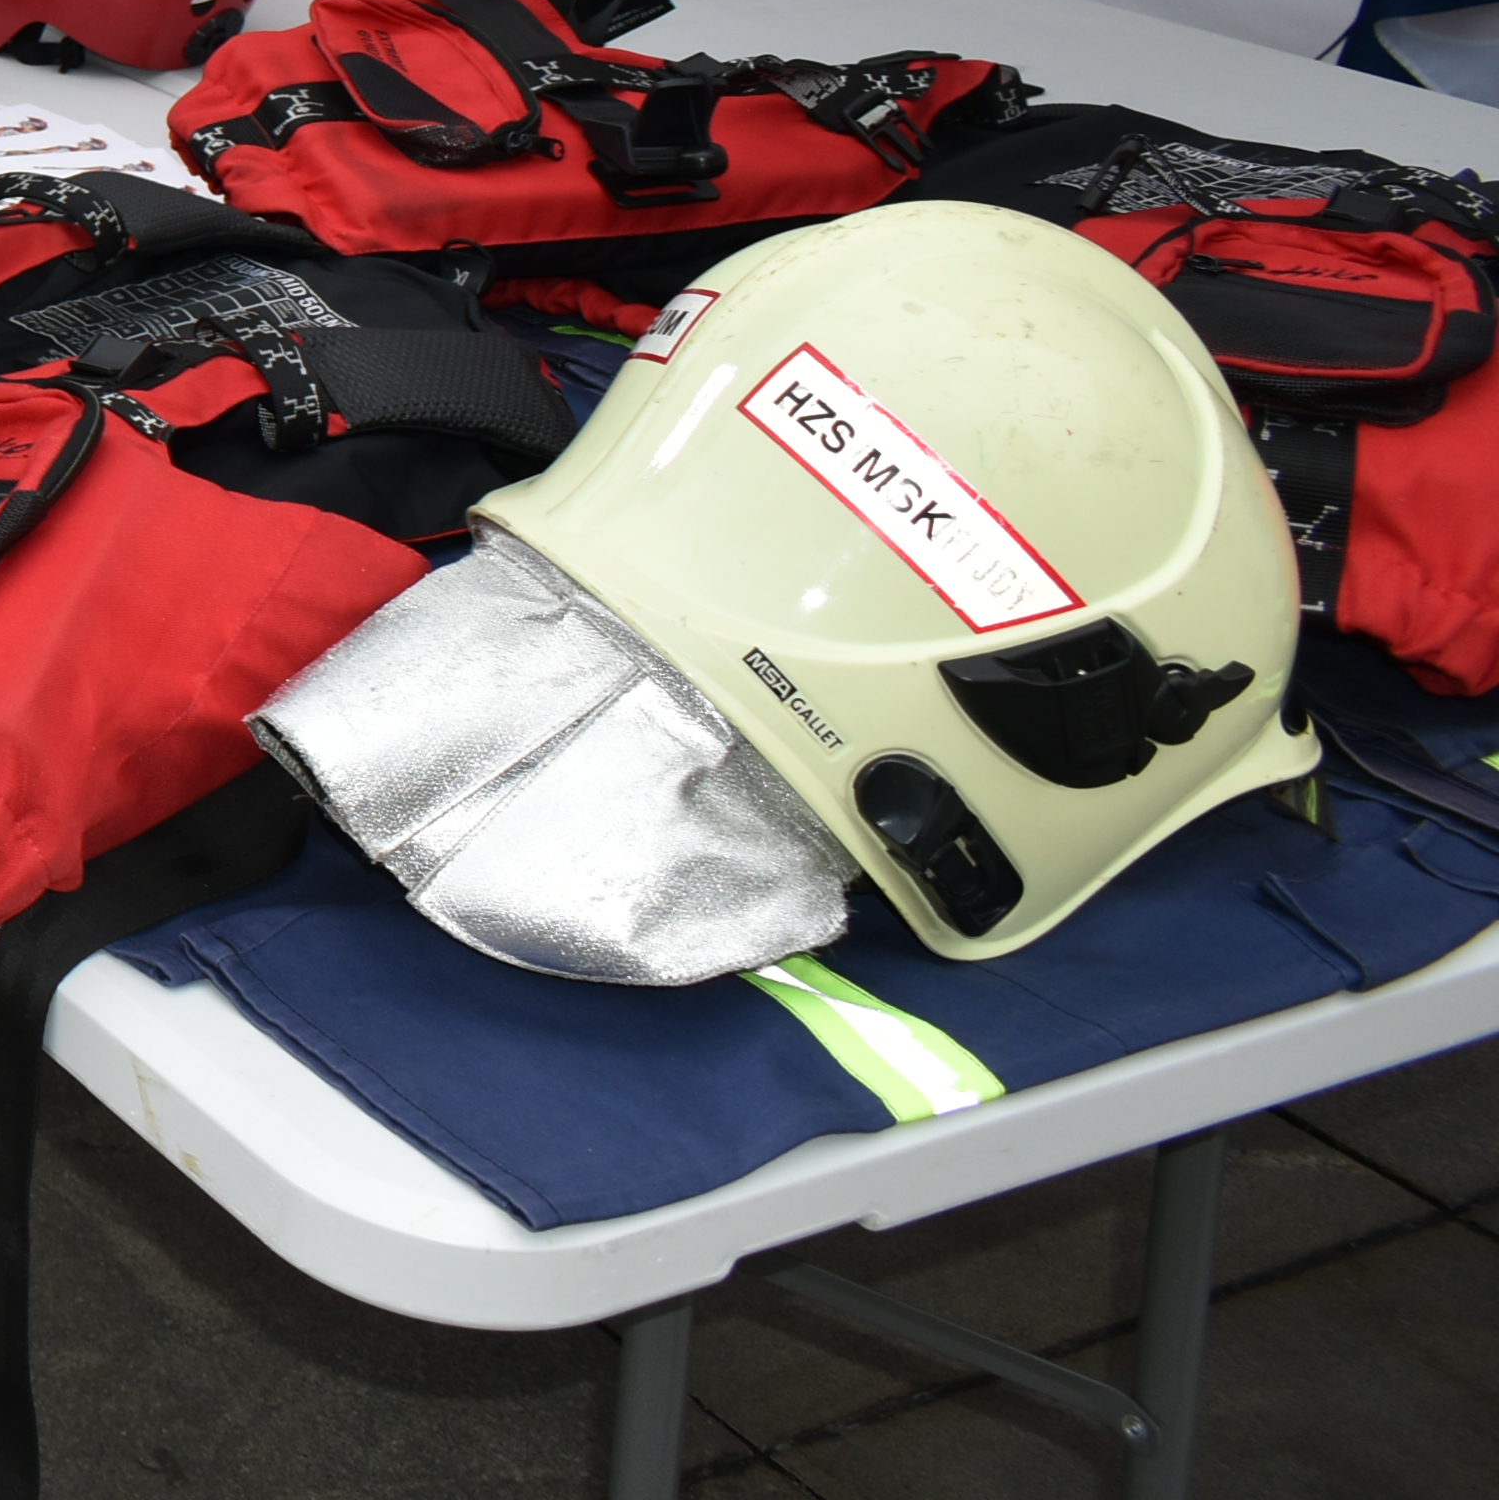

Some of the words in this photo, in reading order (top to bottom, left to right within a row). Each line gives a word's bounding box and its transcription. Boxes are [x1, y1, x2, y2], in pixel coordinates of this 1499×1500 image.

[276, 276, 307, 298] AID
[299, 296, 325, 316] 50
[648, 309, 691, 337] UM
[772, 380, 856, 454] HZS
[851, 447, 957, 541] MSK
[745, 651, 793, 699] MSA
[789, 697, 844, 750] GALLET
